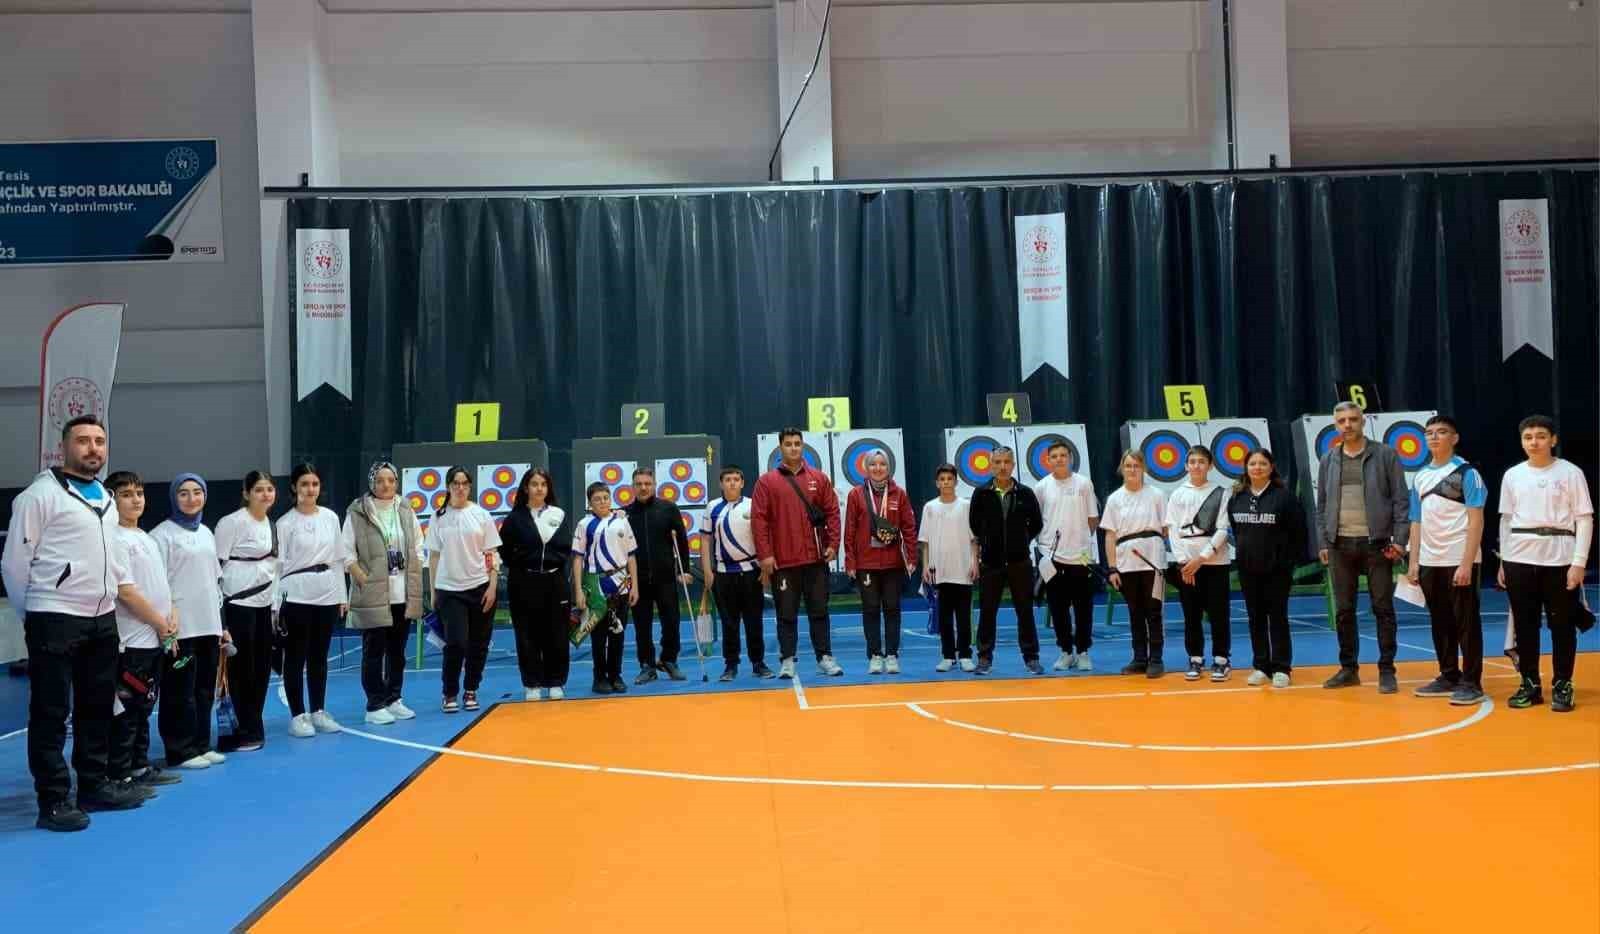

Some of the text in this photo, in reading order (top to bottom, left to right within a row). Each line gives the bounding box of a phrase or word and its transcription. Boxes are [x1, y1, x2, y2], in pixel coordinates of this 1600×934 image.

[0, 169, 30, 181] Tesis
[38, 185, 57, 198] VE
[59, 185, 96, 198] SPOR
[98, 180, 173, 197] BAKANLIĞI
[0, 247, 16, 259] 23
[1001, 398, 1018, 423] 4
[1179, 391, 1195, 417] 5
[1350, 384, 1367, 411] 6
[473, 410, 481, 436] 1
[634, 408, 649, 434] 2
[822, 403, 836, 429] 3
